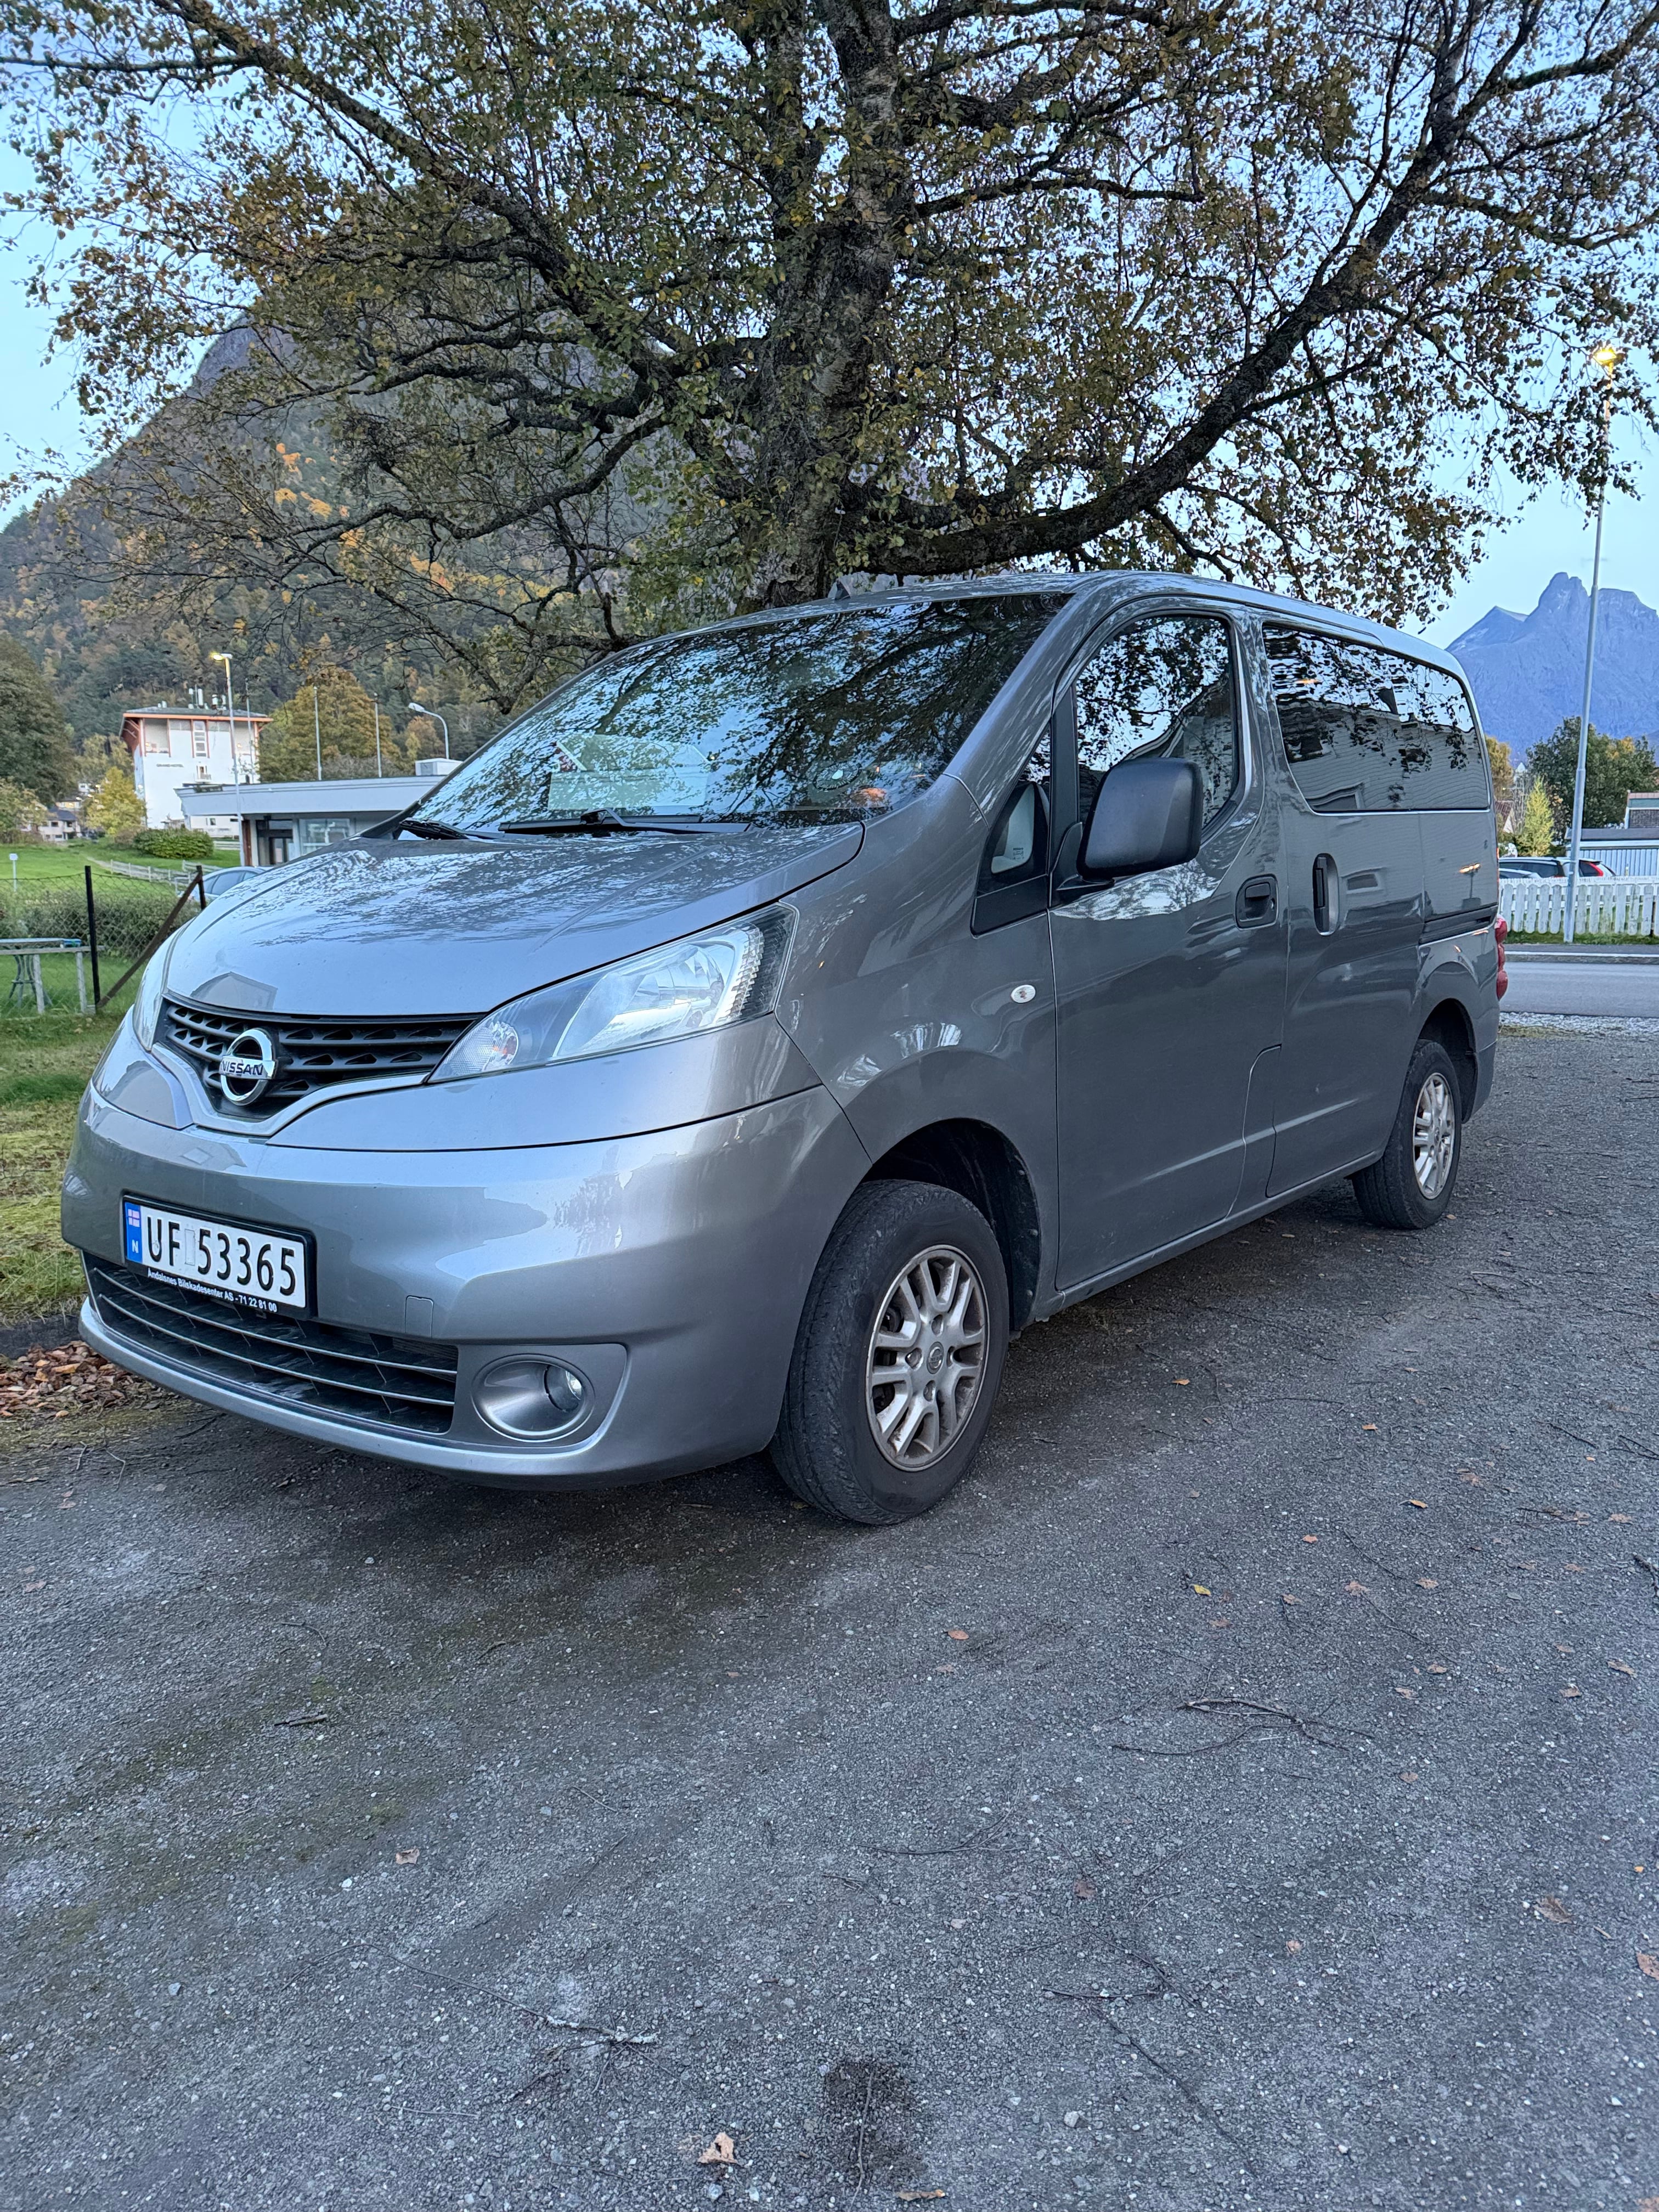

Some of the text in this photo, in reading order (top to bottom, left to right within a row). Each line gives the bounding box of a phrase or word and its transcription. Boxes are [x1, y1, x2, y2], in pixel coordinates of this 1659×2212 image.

[222, 1060, 264, 1076] NISSAN
[132, 1239, 139, 1254] N
[147, 1216, 296, 1296] UF 53365
[178, 1278, 223, 1299] Bilskadesenter
[224, 1290, 234, 1301] AS
[239, 1295, 247, 1305] 71
[248, 1297, 258, 1308] 22
[258, 1299, 267, 1310] 81
[268, 1302, 278, 1313] 00
